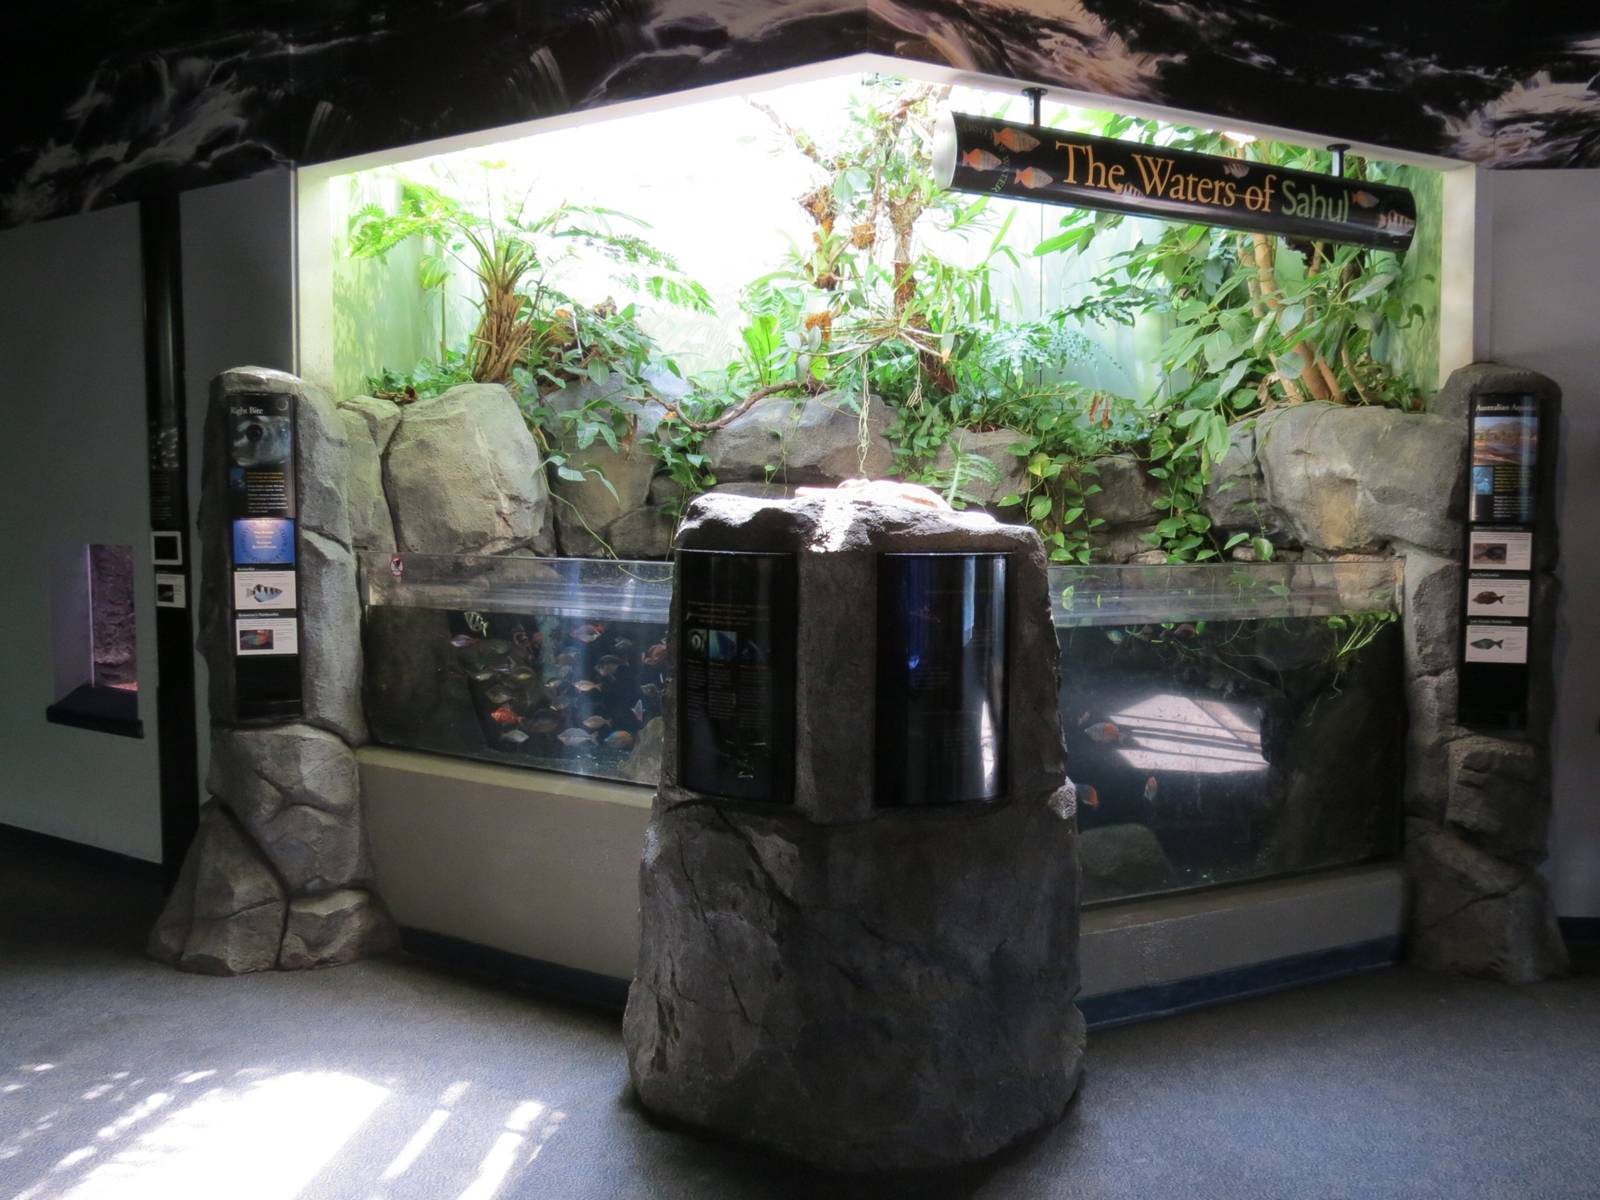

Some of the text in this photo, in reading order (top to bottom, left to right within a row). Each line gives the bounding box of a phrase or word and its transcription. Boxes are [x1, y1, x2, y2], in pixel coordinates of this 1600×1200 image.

[1056, 141, 1348, 223] The Waters of Sahul
